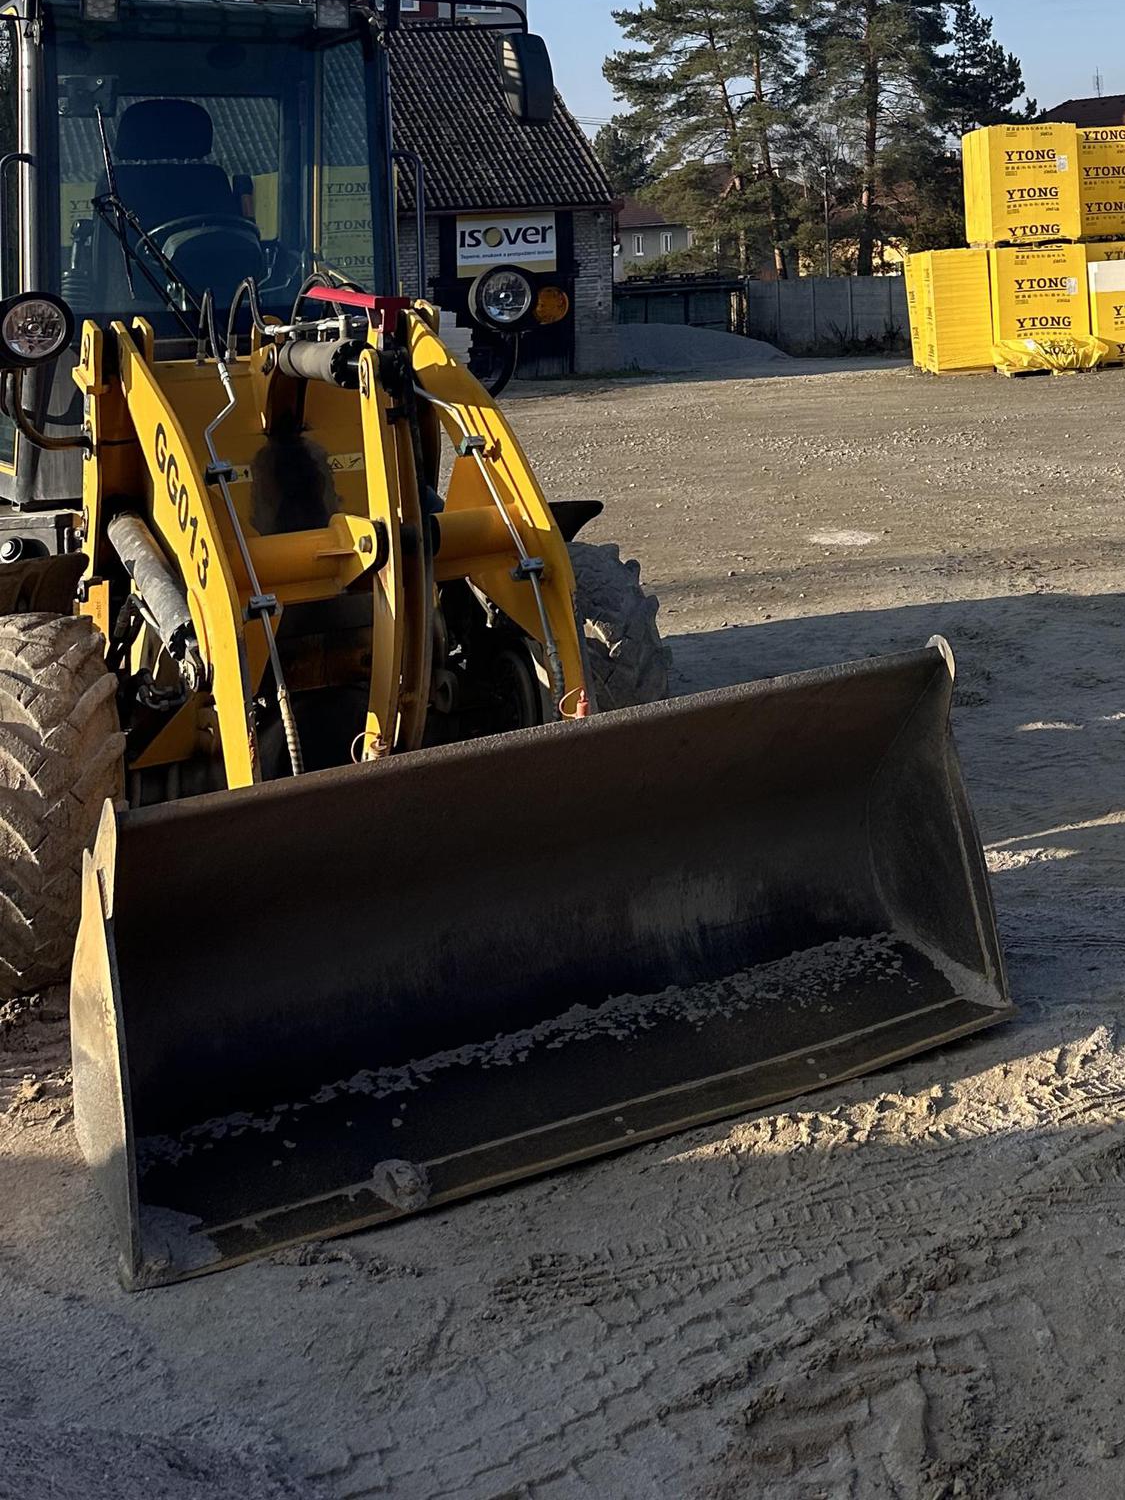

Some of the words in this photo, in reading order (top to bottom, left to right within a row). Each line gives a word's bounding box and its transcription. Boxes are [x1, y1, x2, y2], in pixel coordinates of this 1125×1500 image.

[1005, 149, 1057, 161] YTONG
[326, 182, 372, 194] YTON
[1006, 186, 1059, 200] YTONG
[1008, 223, 1060, 237] YTONG
[1014, 276, 1069, 290] YTONG
[1016, 316, 1072, 329] YTONG
[155, 422, 209, 590] GG013
